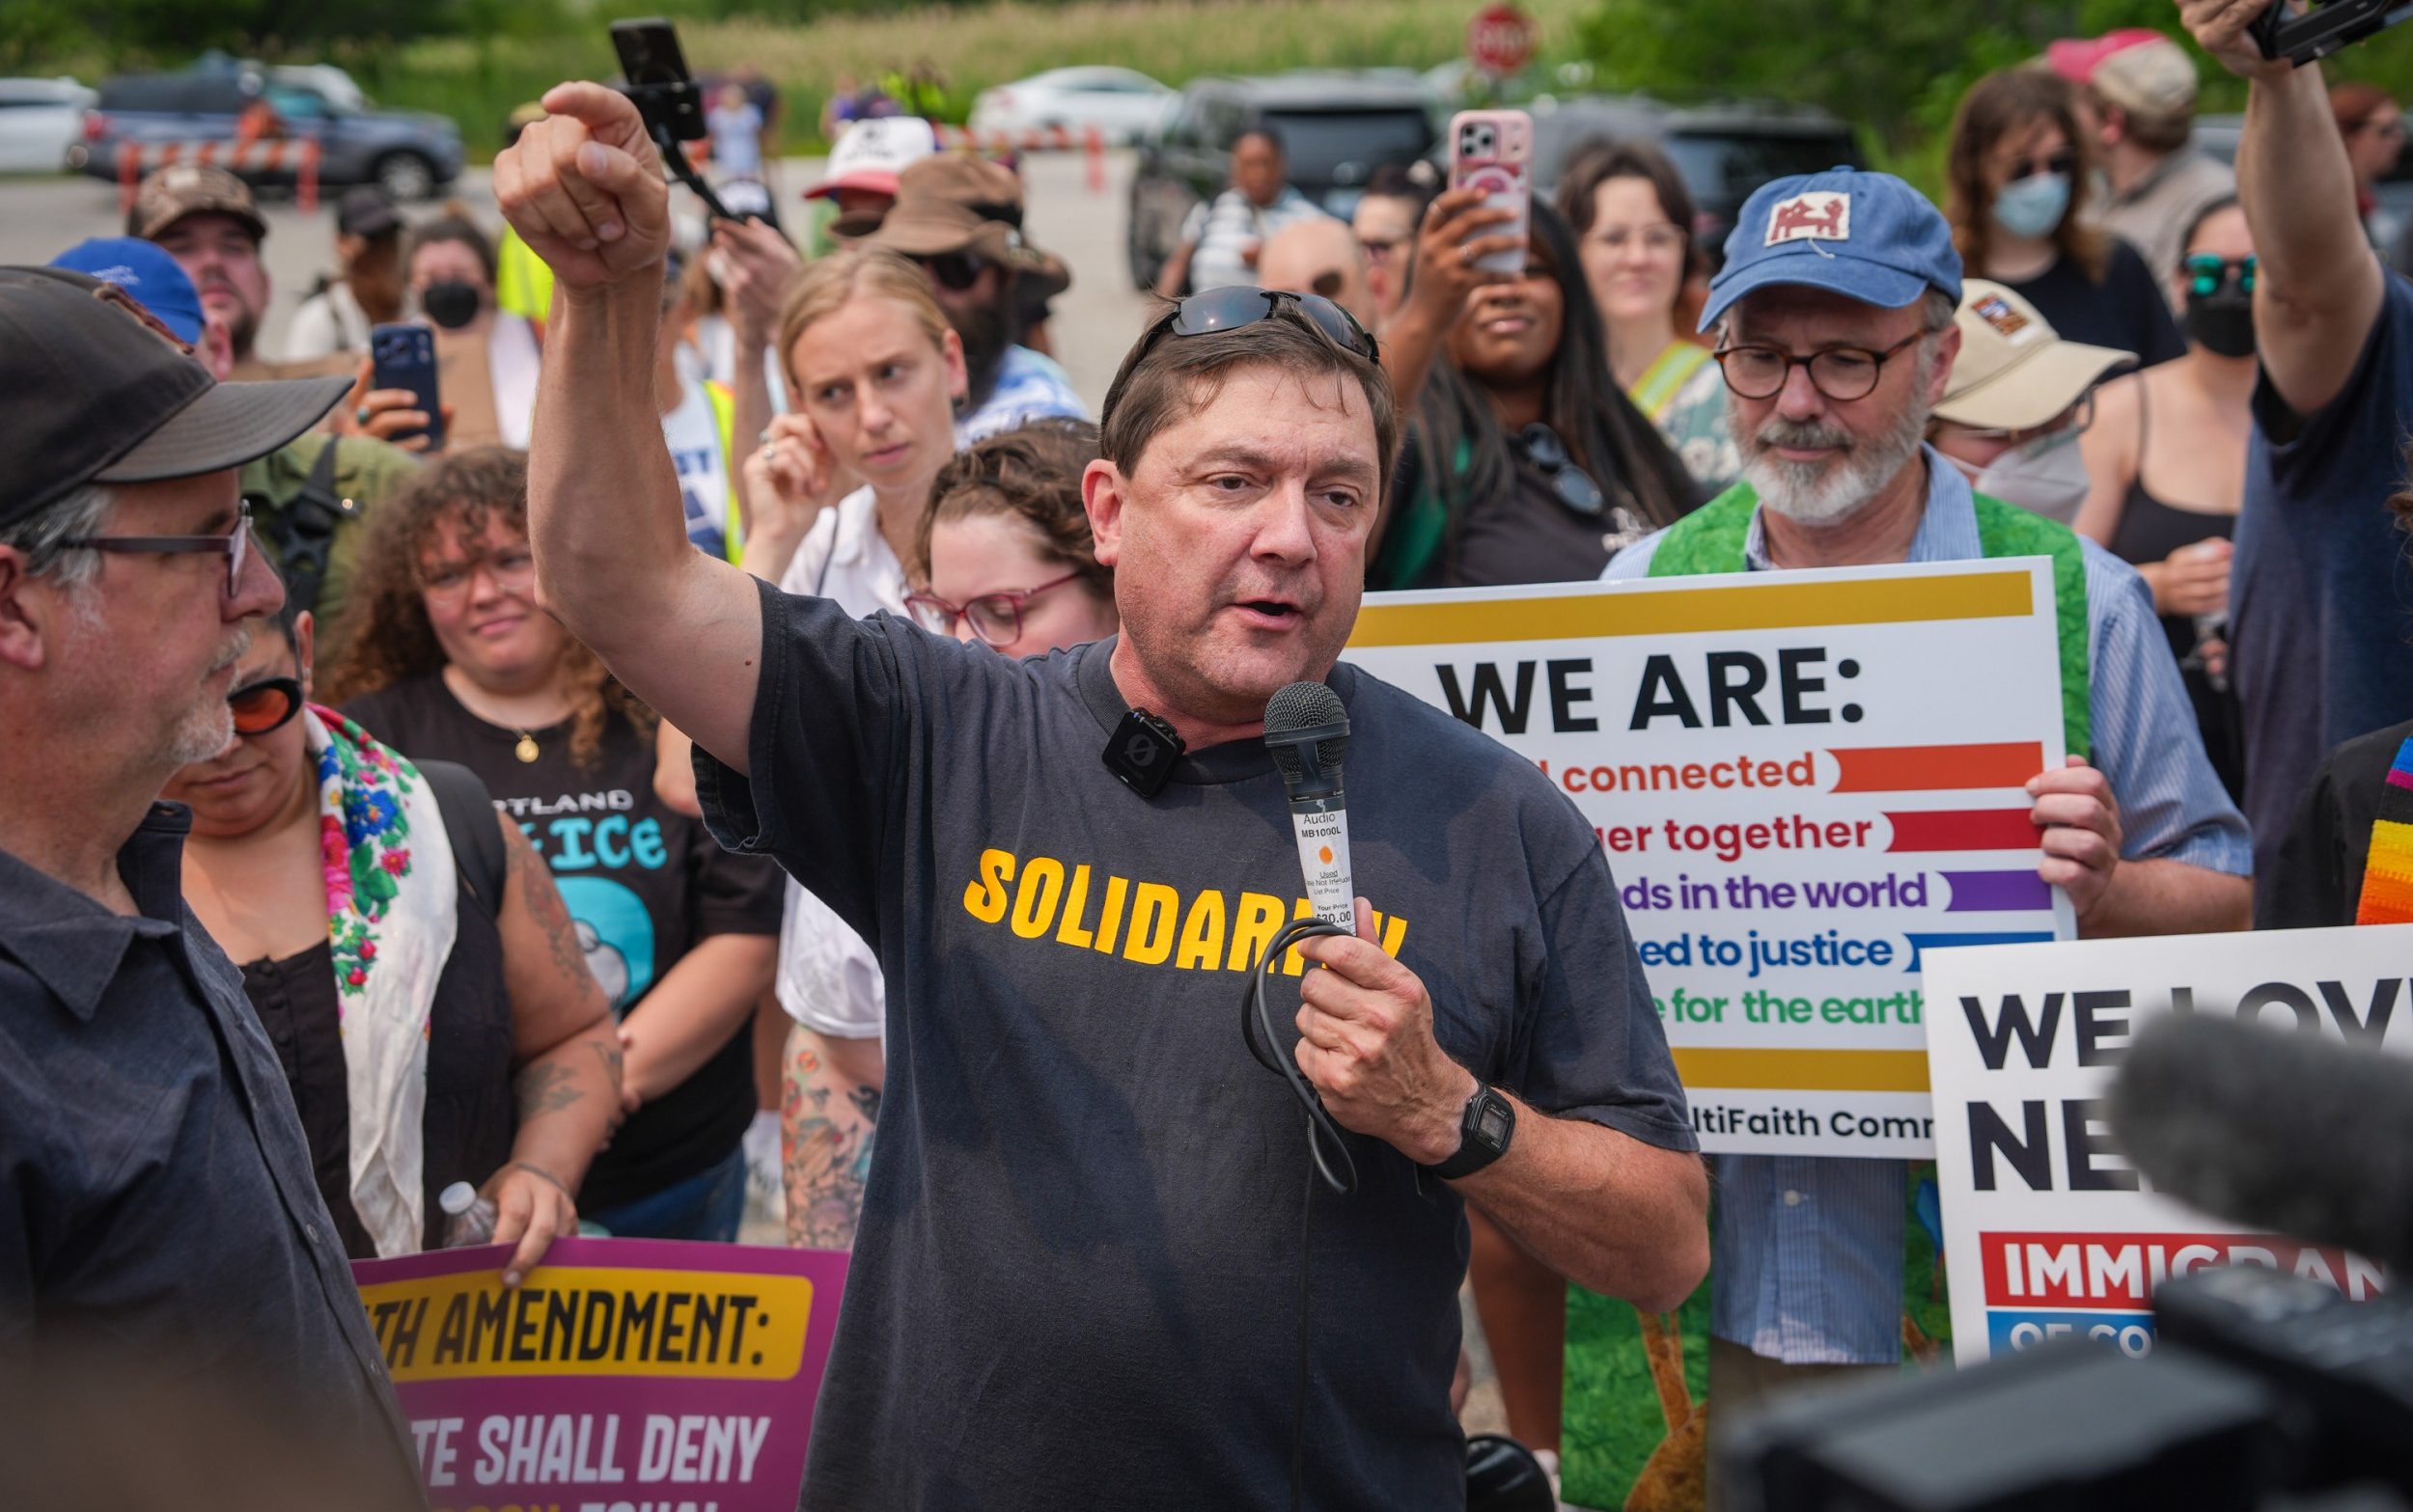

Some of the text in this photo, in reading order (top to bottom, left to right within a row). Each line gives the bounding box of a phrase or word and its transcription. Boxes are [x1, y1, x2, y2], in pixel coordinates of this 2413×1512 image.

[1434, 647, 1865, 734] WE ARE:
[1562, 752, 1817, 792] connected
[1302, 826, 1342, 838] MB1000L
[1304, 812, 1336, 824] Audio
[1664, 814, 1872, 863] together
[1678, 874, 1719, 909] in
[1726, 875, 1796, 909] the
[1802, 872, 1928, 908] world
[1699, 935, 1742, 966] to
[1747, 930, 1894, 977] justice
[1672, 988, 1730, 1023] for
[1742, 990, 1813, 1024] the
[1959, 990, 2131, 1070] WE
[364, 1289, 769, 1368] TH AMENDMENT:
[474, 1415, 624, 1486] SHALL
[637, 1415, 771, 1483] DENY
